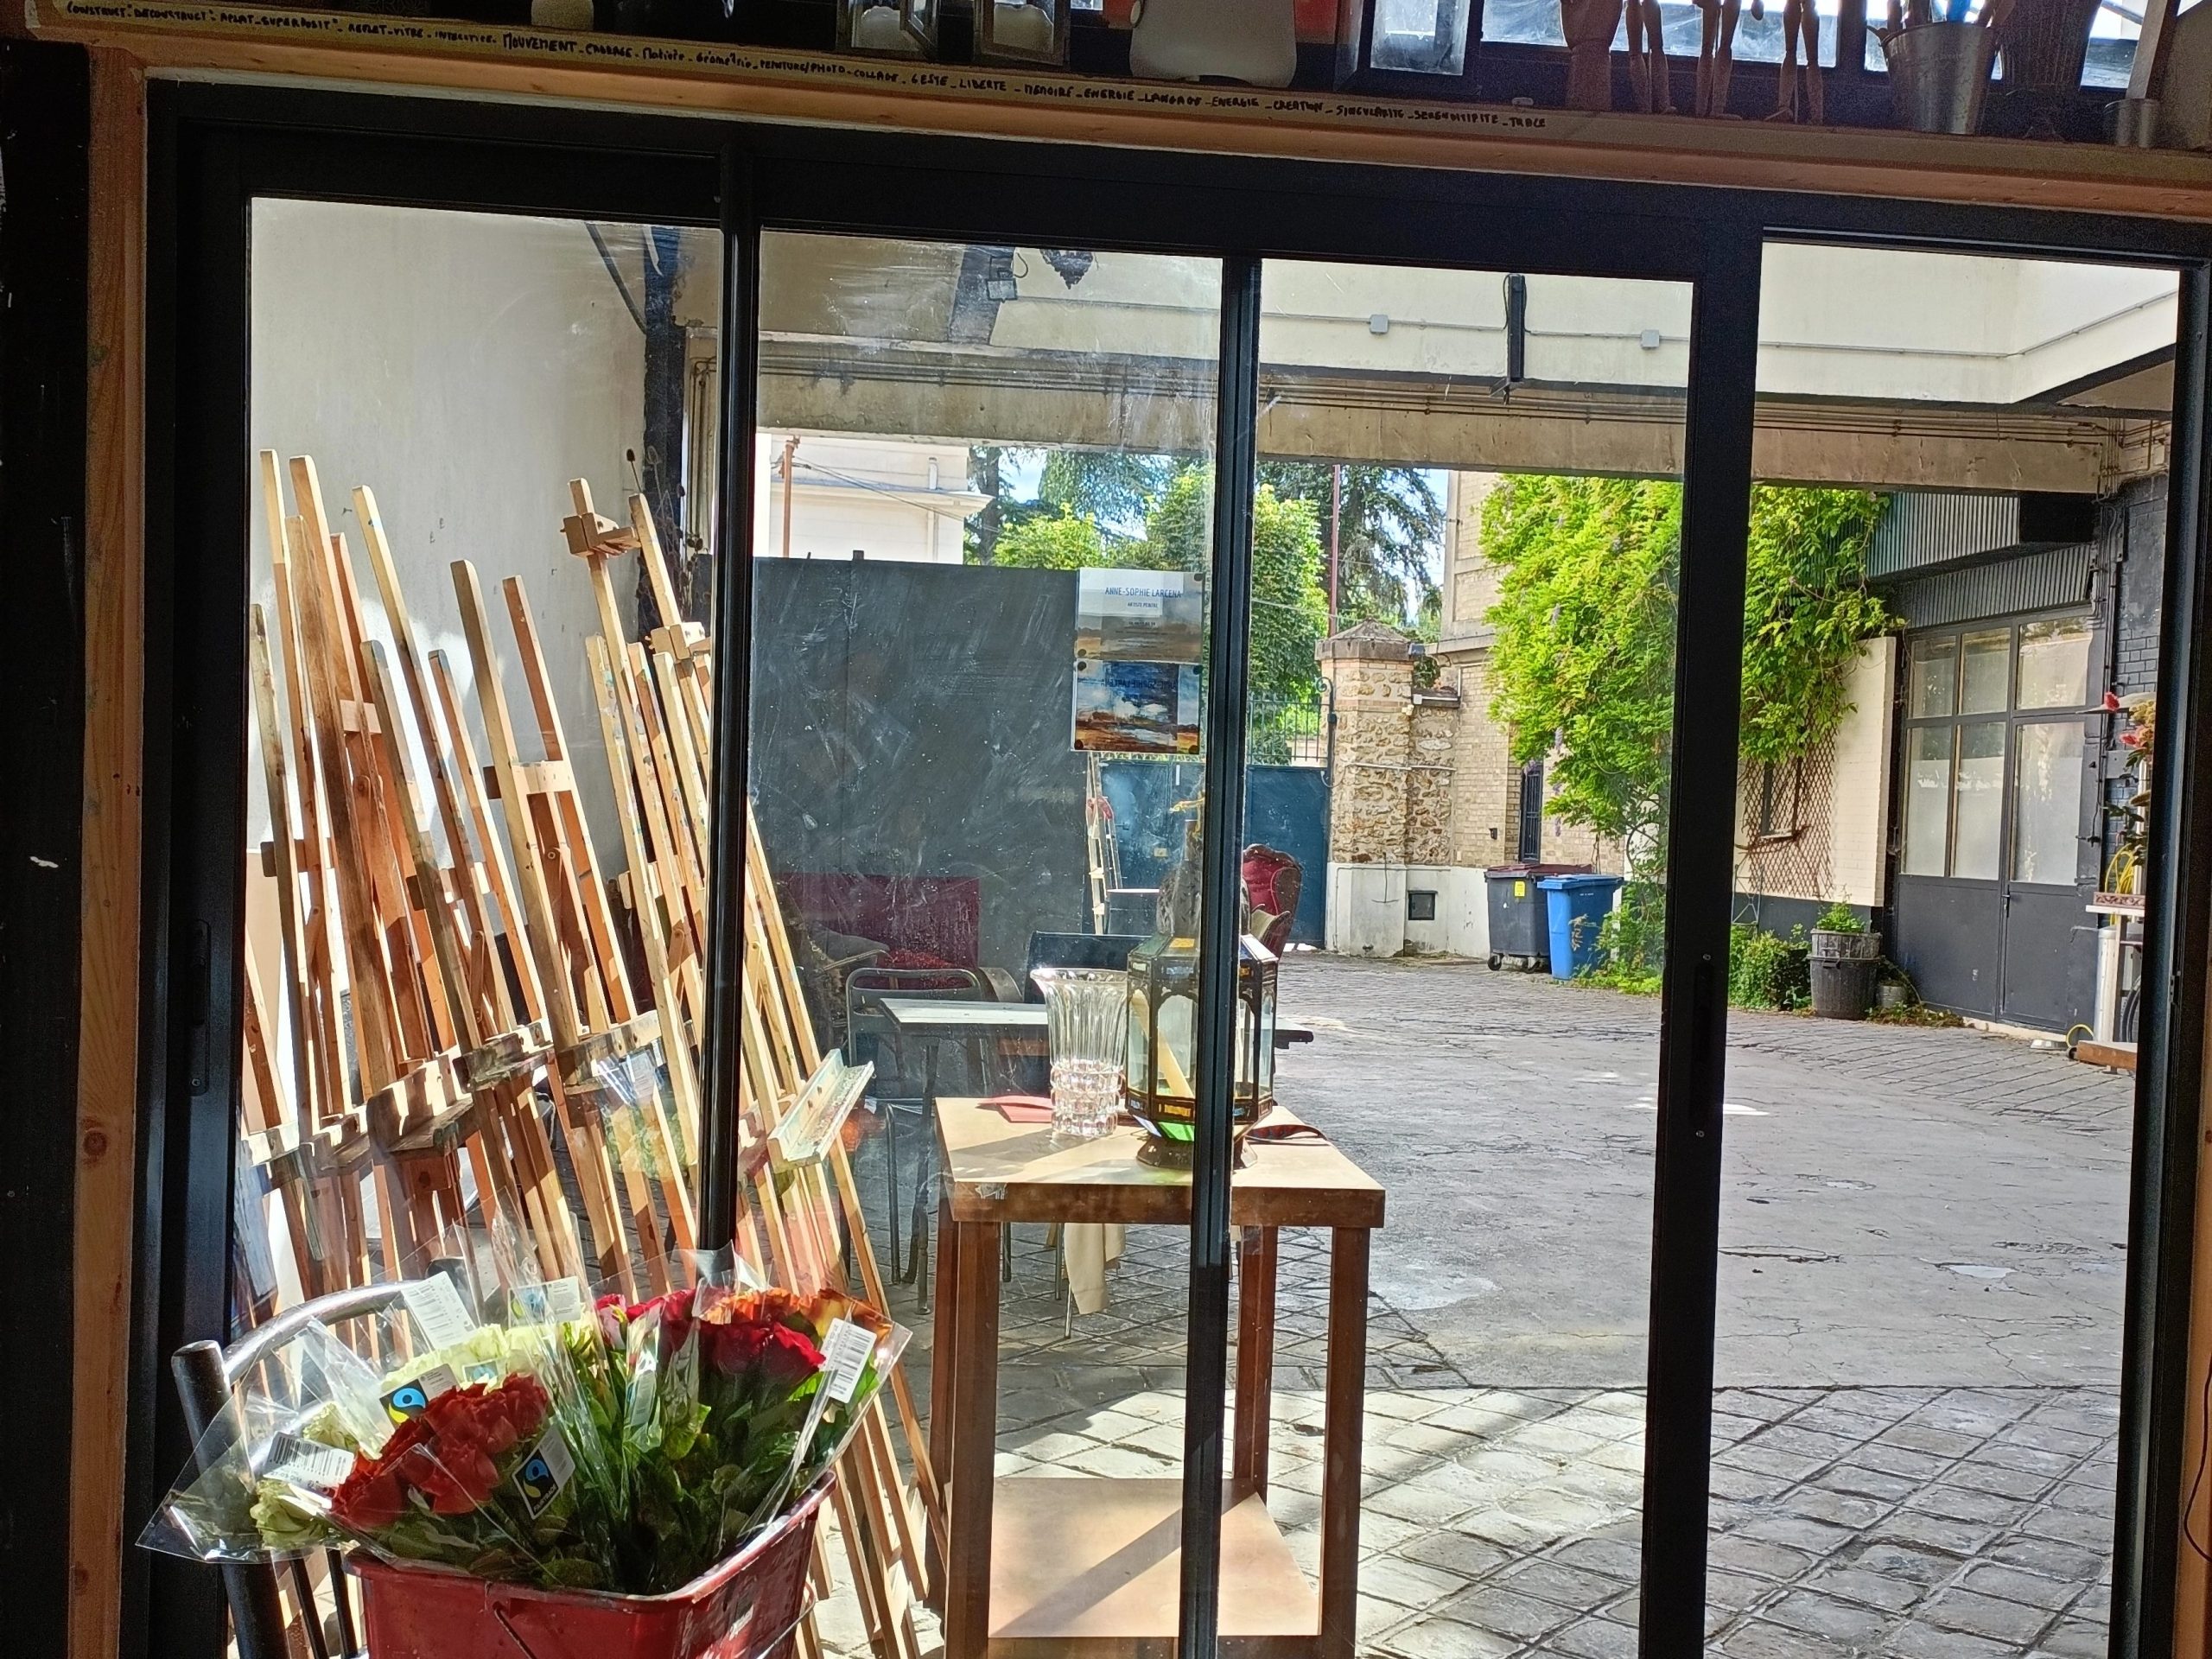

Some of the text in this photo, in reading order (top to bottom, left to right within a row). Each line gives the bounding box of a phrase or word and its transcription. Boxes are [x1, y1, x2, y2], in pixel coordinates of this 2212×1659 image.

[503, 32, 578, 53] MOUVEMENT
[912, 73, 949, 86] GESTE
[1084, 88, 1135, 101] ENERGIE
[1211, 96, 1259, 108] ENERGIE
[1104, 587, 1150, 597] ANNE-SOPHIE
